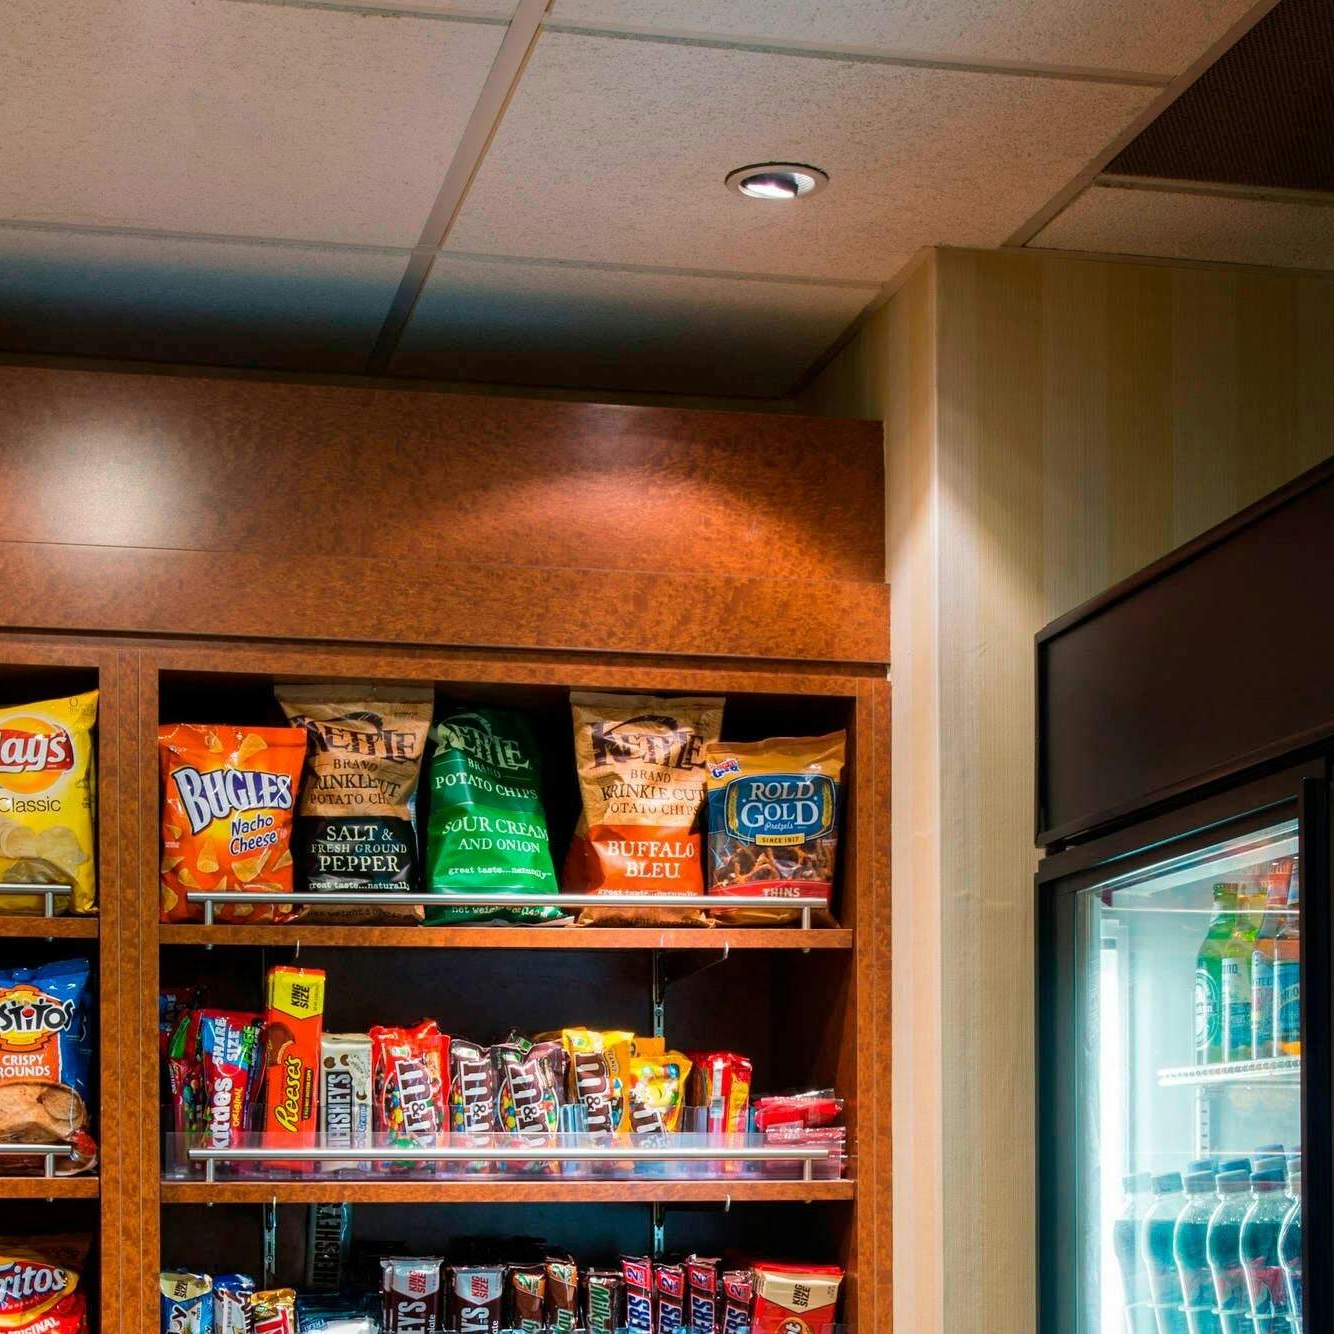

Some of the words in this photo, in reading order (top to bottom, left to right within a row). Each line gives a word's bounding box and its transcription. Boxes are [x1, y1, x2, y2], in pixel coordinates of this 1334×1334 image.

[333, 758, 380, 773] BRAND
[630, 769, 672, 783] BRAND
[434, 771, 493, 793] POTATO
[495, 784, 539, 800] CHIPS
[750, 781, 815, 801] ROLD
[172, 767, 293, 836] BUGLES
[309, 792, 364, 806] POTATO
[661, 803, 700, 816] CHIPS
[741, 799, 818, 829] GOLD
[230, 813, 274, 837] Nacho
[326, 825, 378, 842] SALT
[382, 828, 395, 841] &
[442, 815, 494, 835] SOUR
[495, 818, 549, 842] CREAM
[229, 831, 278, 856] Cheese
[311, 842, 349, 854] FRESH
[354, 842, 408, 854] GROUND
[458, 837, 493, 851] AND
[496, 838, 541, 854] ONION
[607, 840, 695, 859] BUFFALO
[761, 836, 782, 845] SINCE
[319, 855, 401, 873] PEPPER
[624, 862, 680, 879] BLEU
[291, 983, 303, 1008] KING
[299, 984, 311, 1010] SIZE
[212, 1018, 228, 1065] SHARE
[226, 1029, 241, 1062] SIZE
[2, 1053, 45, 1067] CRISPY
[274, 1055, 303, 1133] Reese's
[471, 1275, 480, 1297] KING
[479, 1277, 489, 1299] SIZE
[792, 1284, 802, 1305] KING
[800, 1285, 811, 1308] SIZE
